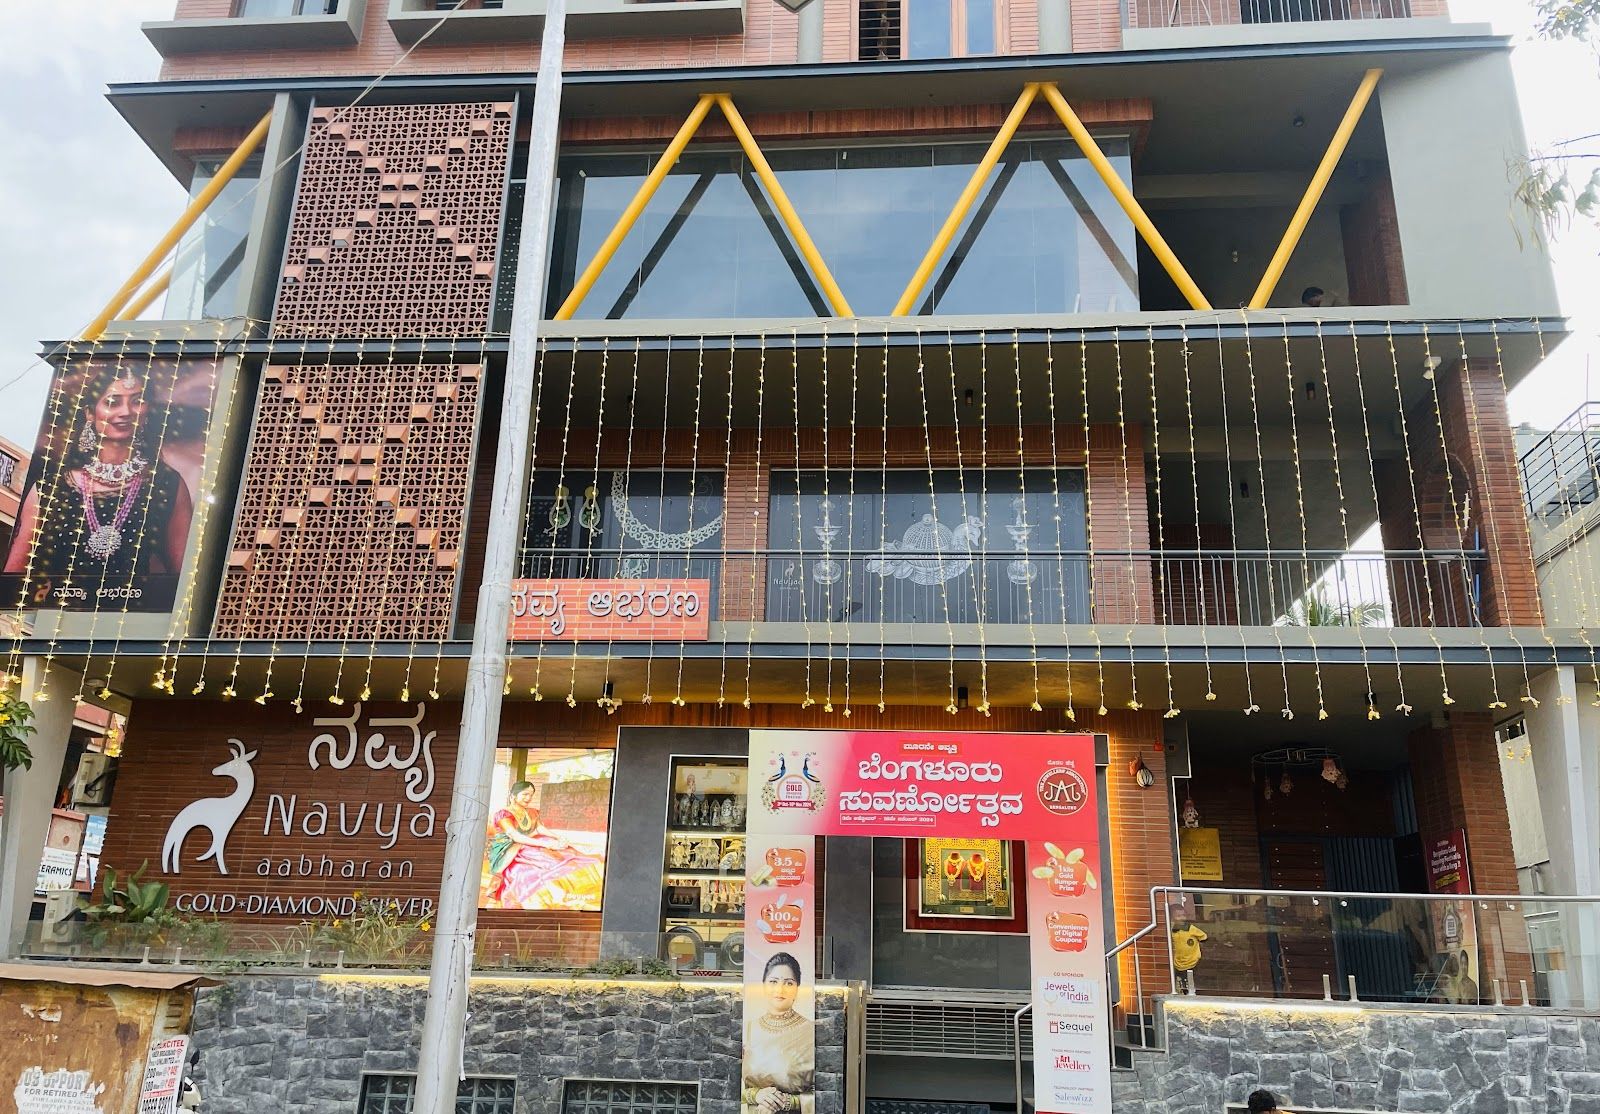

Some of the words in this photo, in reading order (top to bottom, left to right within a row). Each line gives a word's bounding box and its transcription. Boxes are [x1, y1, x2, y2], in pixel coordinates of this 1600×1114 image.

[588, 584, 700, 621] ಆಭರಣ
[308, 701, 437, 802] ನವ್ಯ
[858, 753, 1003, 783] ಬೆಂಗಳೂರು
[786, 784, 803, 792] GOLD
[839, 784, 1023, 827] ಸುವರ್ಣೋತ್ಸವ
[263, 794, 450, 849] Navya
[257, 854, 413, 878] aabharan
[774, 857, 793, 867] 3.5
[40, 864, 73, 876] ERAMICS
[1054, 878, 1078, 886] Bumper
[176, 892, 237, 914] GOLD
[246, 894, 357, 917] DIAMOND
[769, 911, 791, 921] 100
[1048, 923, 1089, 931] Convenience
[1054, 936, 1083, 944] Coupons
[1044, 981, 1075, 992] Jewels
[1067, 992, 1089, 1001] India
[1059, 1021, 1093, 1032] Sequel
[1054, 1060, 1091, 1071] Jewellery
[43, 1089, 77, 1098] RETIRED
